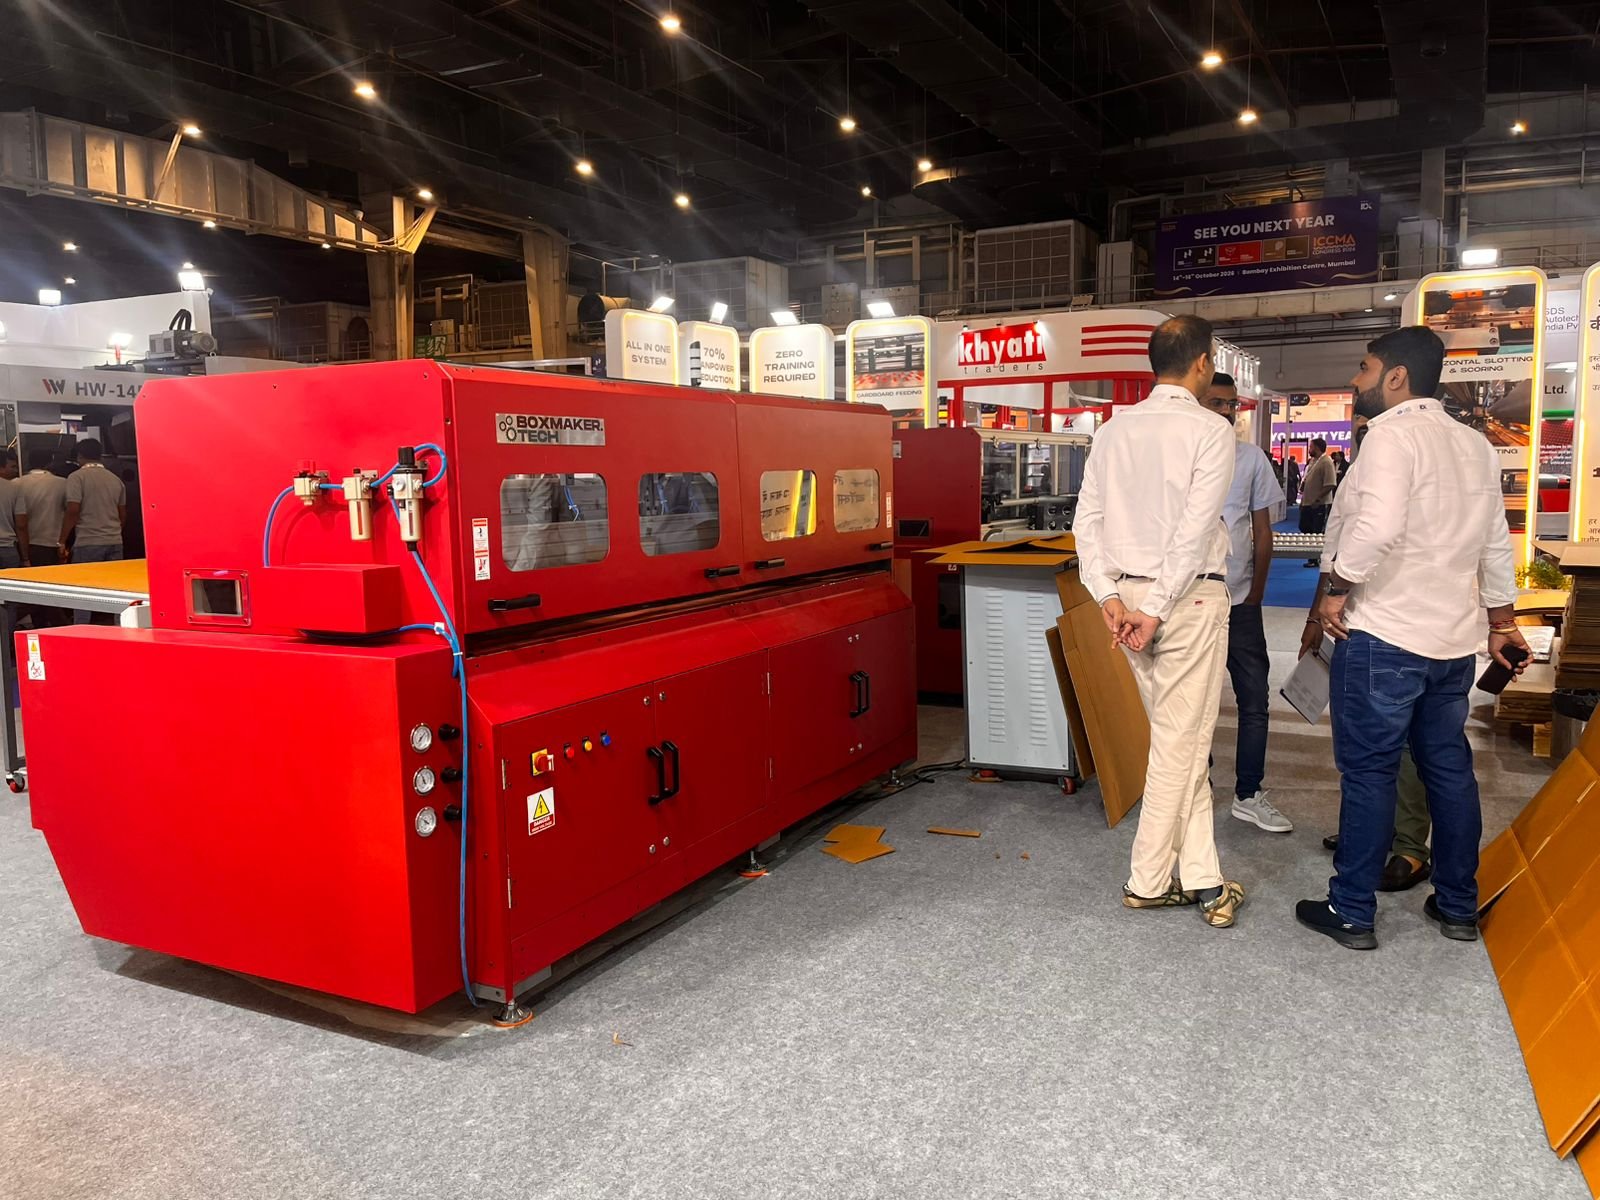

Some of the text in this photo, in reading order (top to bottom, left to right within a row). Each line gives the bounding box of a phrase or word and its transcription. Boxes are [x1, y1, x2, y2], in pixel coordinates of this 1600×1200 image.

[1194, 214, 1335, 240] SEE YOU NEXT YEAR
[1313, 234, 1356, 247] ICCMA
[1195, 271, 1220, 279] October
[1242, 266, 1268, 275] Bombay
[1269, 264, 1301, 273] Exhibition
[1303, 262, 1327, 270] Centre,
[1328, 259, 1356, 267] Mumbai
[1545, 323, 1564, 331] ndia
[626, 340, 671, 353] ALL IN ONE
[958, 330, 1044, 367] khyati
[703, 347, 726, 360] 70%
[776, 350, 803, 359] ZERO
[631, 354, 667, 365] SYSTEM
[1484, 356, 1533, 364] SLOTTING
[700, 361, 735, 373] ANPOWER
[765, 361, 815, 371] TRAINING
[964, 363, 1044, 374] traders
[1460, 365, 1504, 374] SCORING
[700, 373, 734, 385] EDUCTION
[763, 373, 816, 383] REQUIRED
[856, 391, 894, 399] CARDBOARD
[1544, 385, 1568, 395] Ltd.
[517, 430, 560, 442] TECH
[1296, 431, 1328, 440] NEXT
